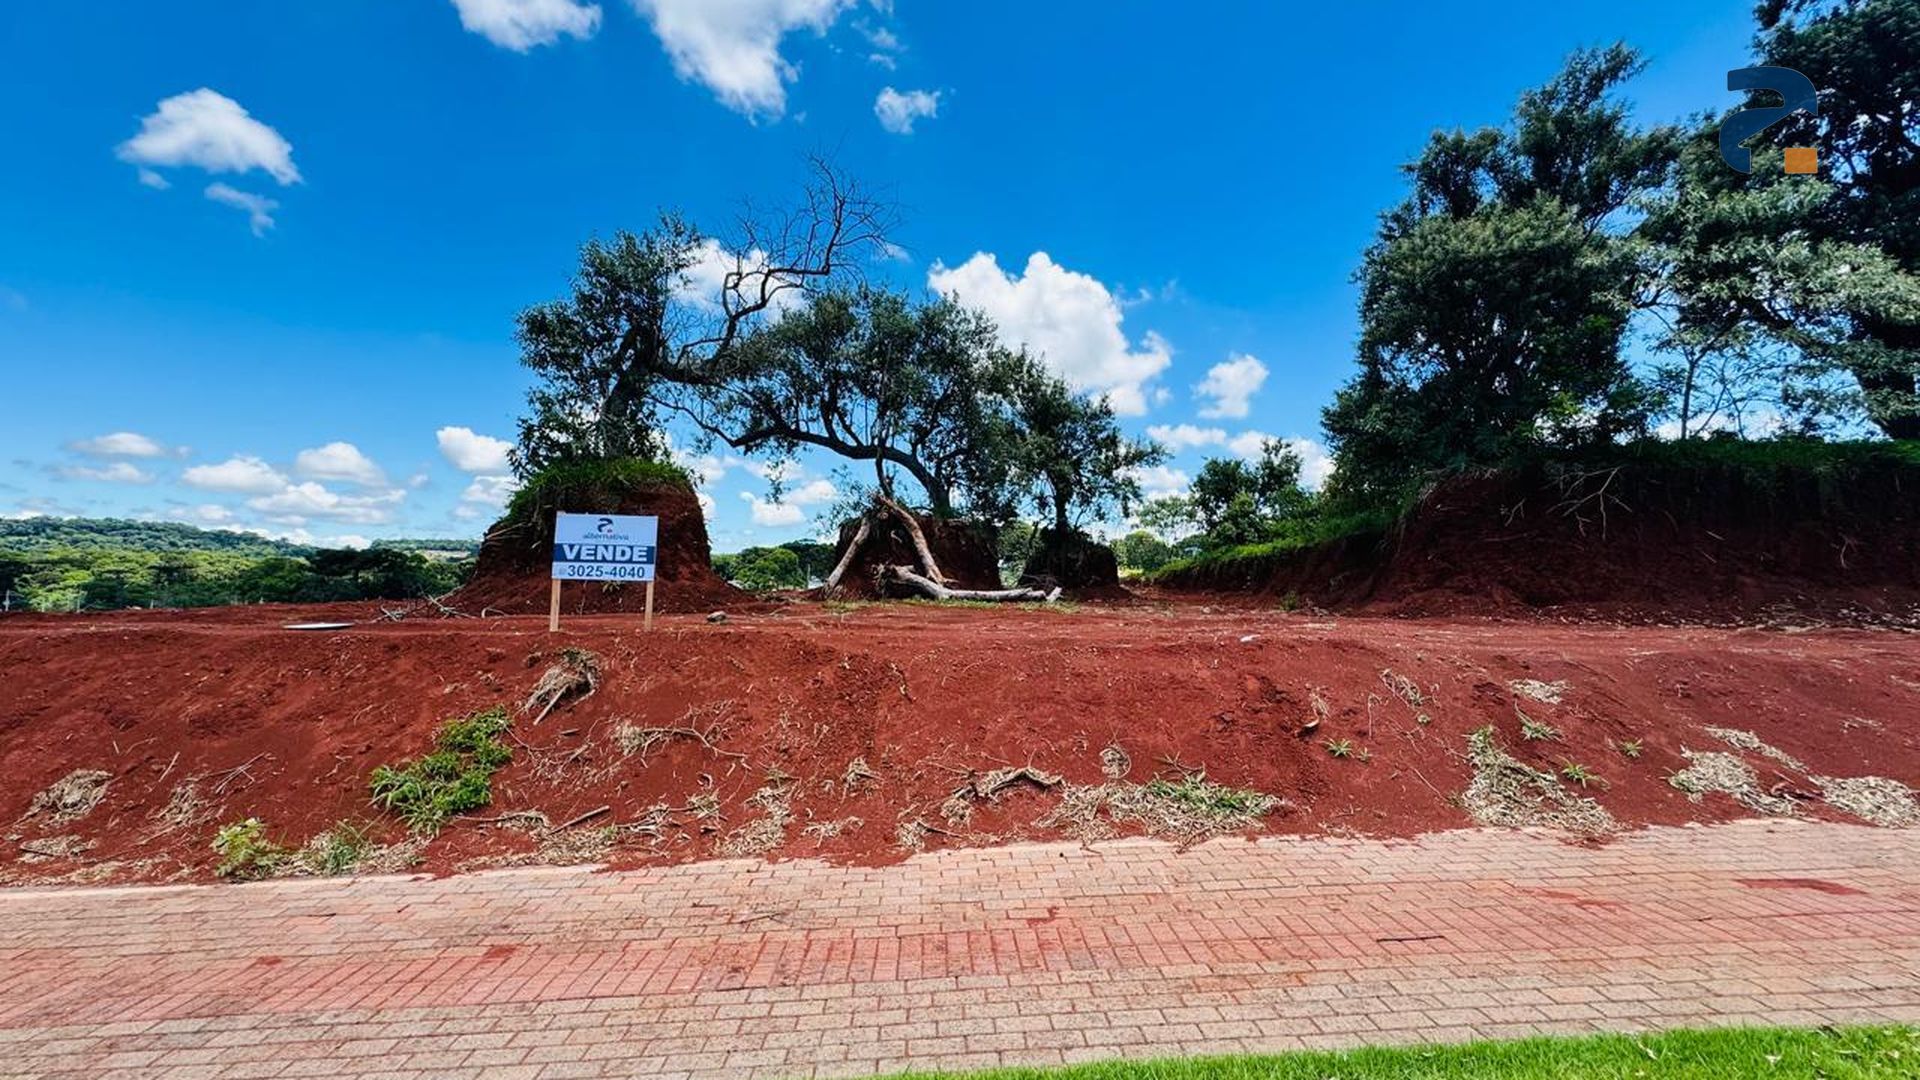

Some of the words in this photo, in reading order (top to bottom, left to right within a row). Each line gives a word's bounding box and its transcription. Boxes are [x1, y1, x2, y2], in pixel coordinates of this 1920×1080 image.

[583, 532, 629, 540] alternativa
[562, 544, 648, 561] VENDE
[567, 565, 645, 578] 3025-4040
